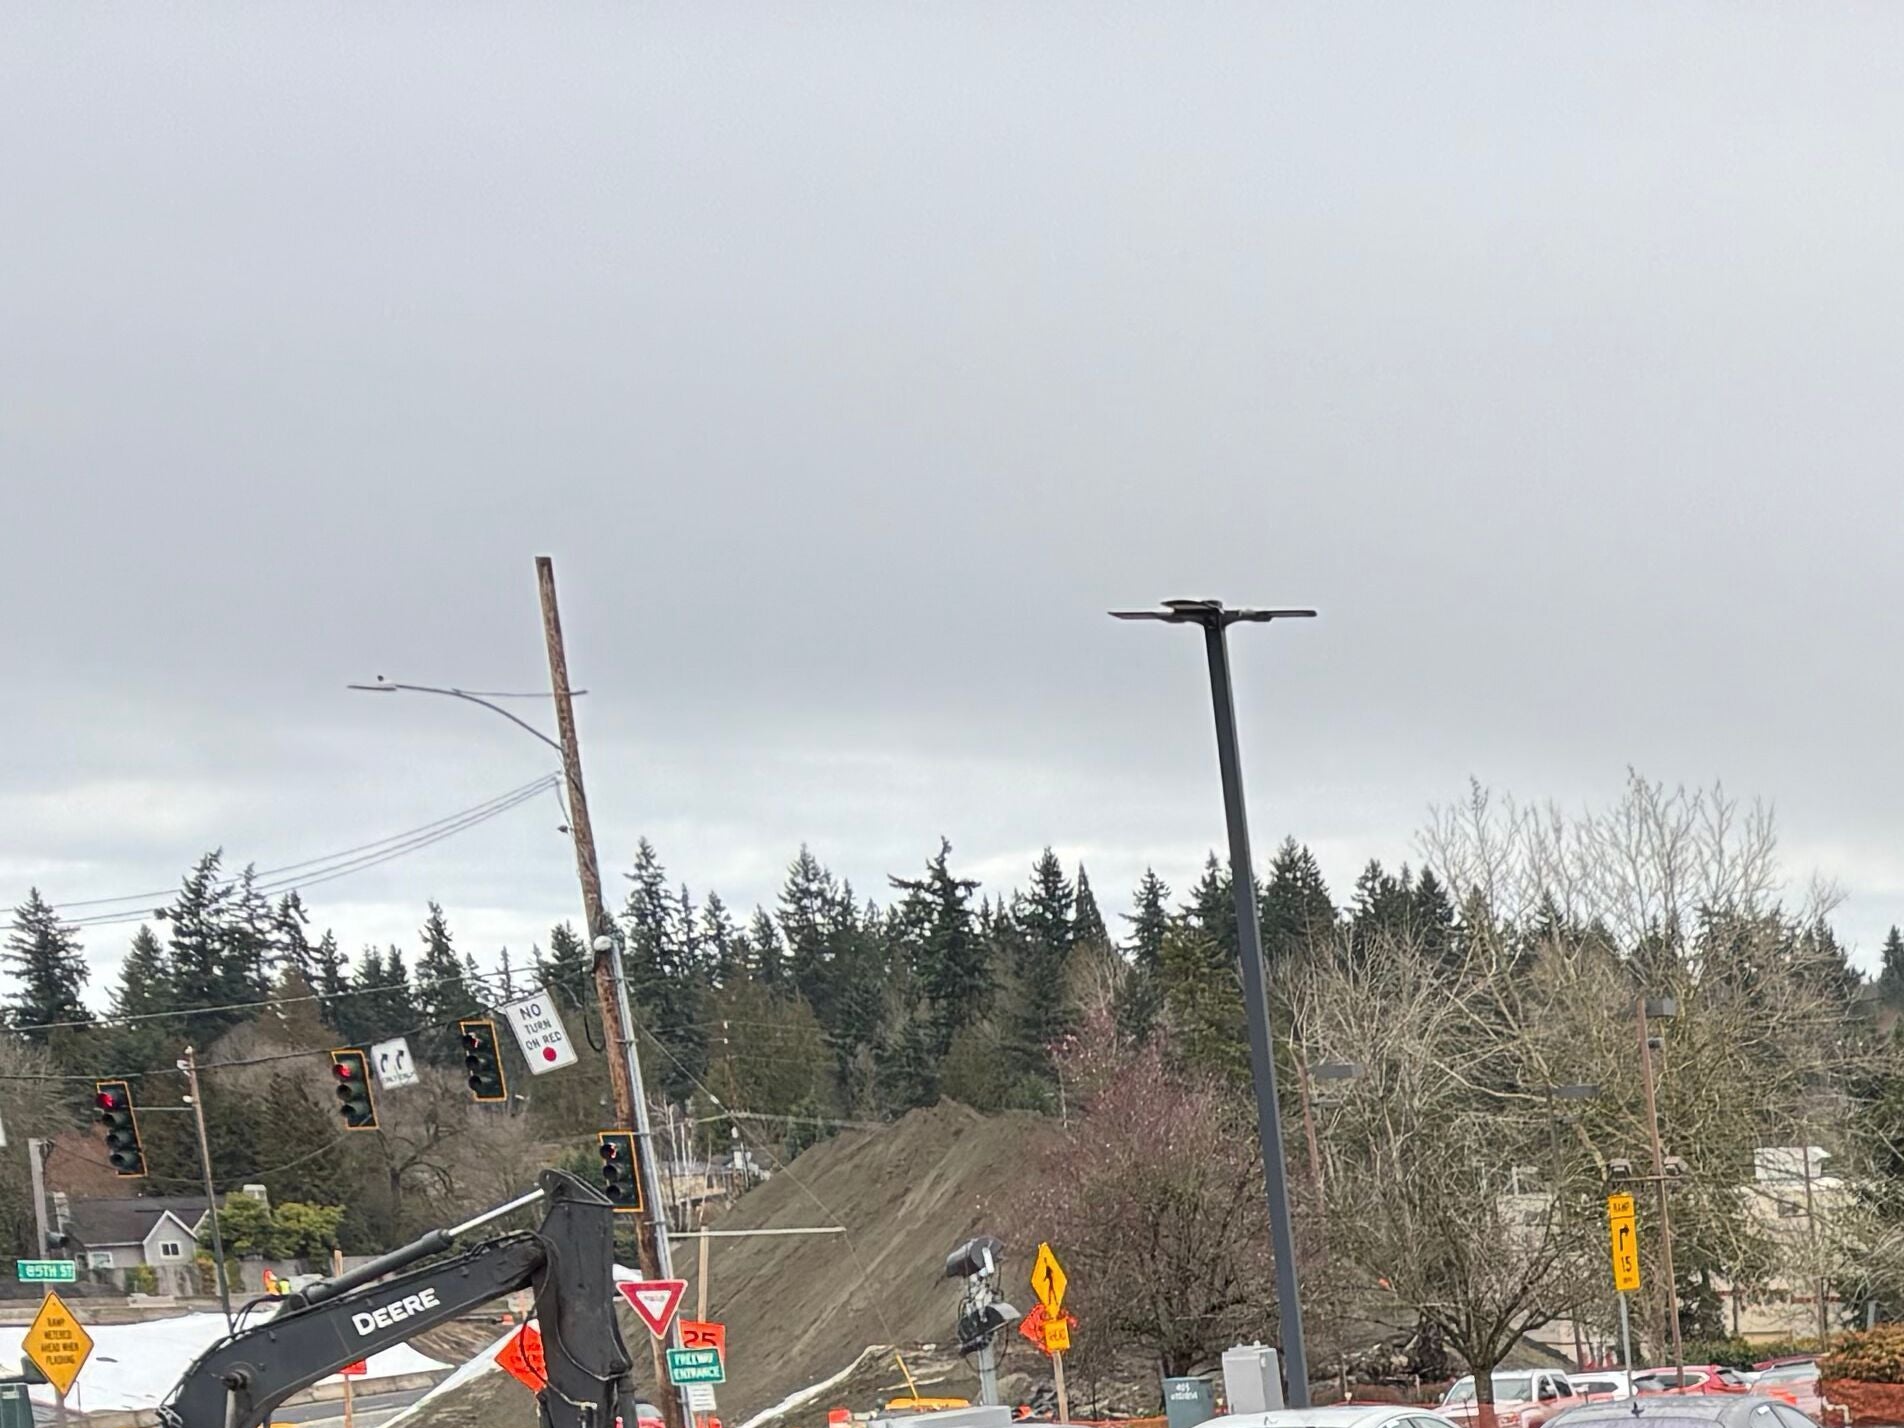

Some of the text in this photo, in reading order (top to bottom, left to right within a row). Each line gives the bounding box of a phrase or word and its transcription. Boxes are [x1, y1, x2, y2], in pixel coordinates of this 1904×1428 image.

[519, 1003, 541, 1020] NO
[524, 1018, 552, 1035] TURN
[525, 1031, 562, 1051] ON RED
[60, 1265, 73, 1278] ST
[1621, 1256, 1632, 1273] 15
[351, 1287, 441, 1337] DEERE
[683, 1330, 717, 1348] 25
